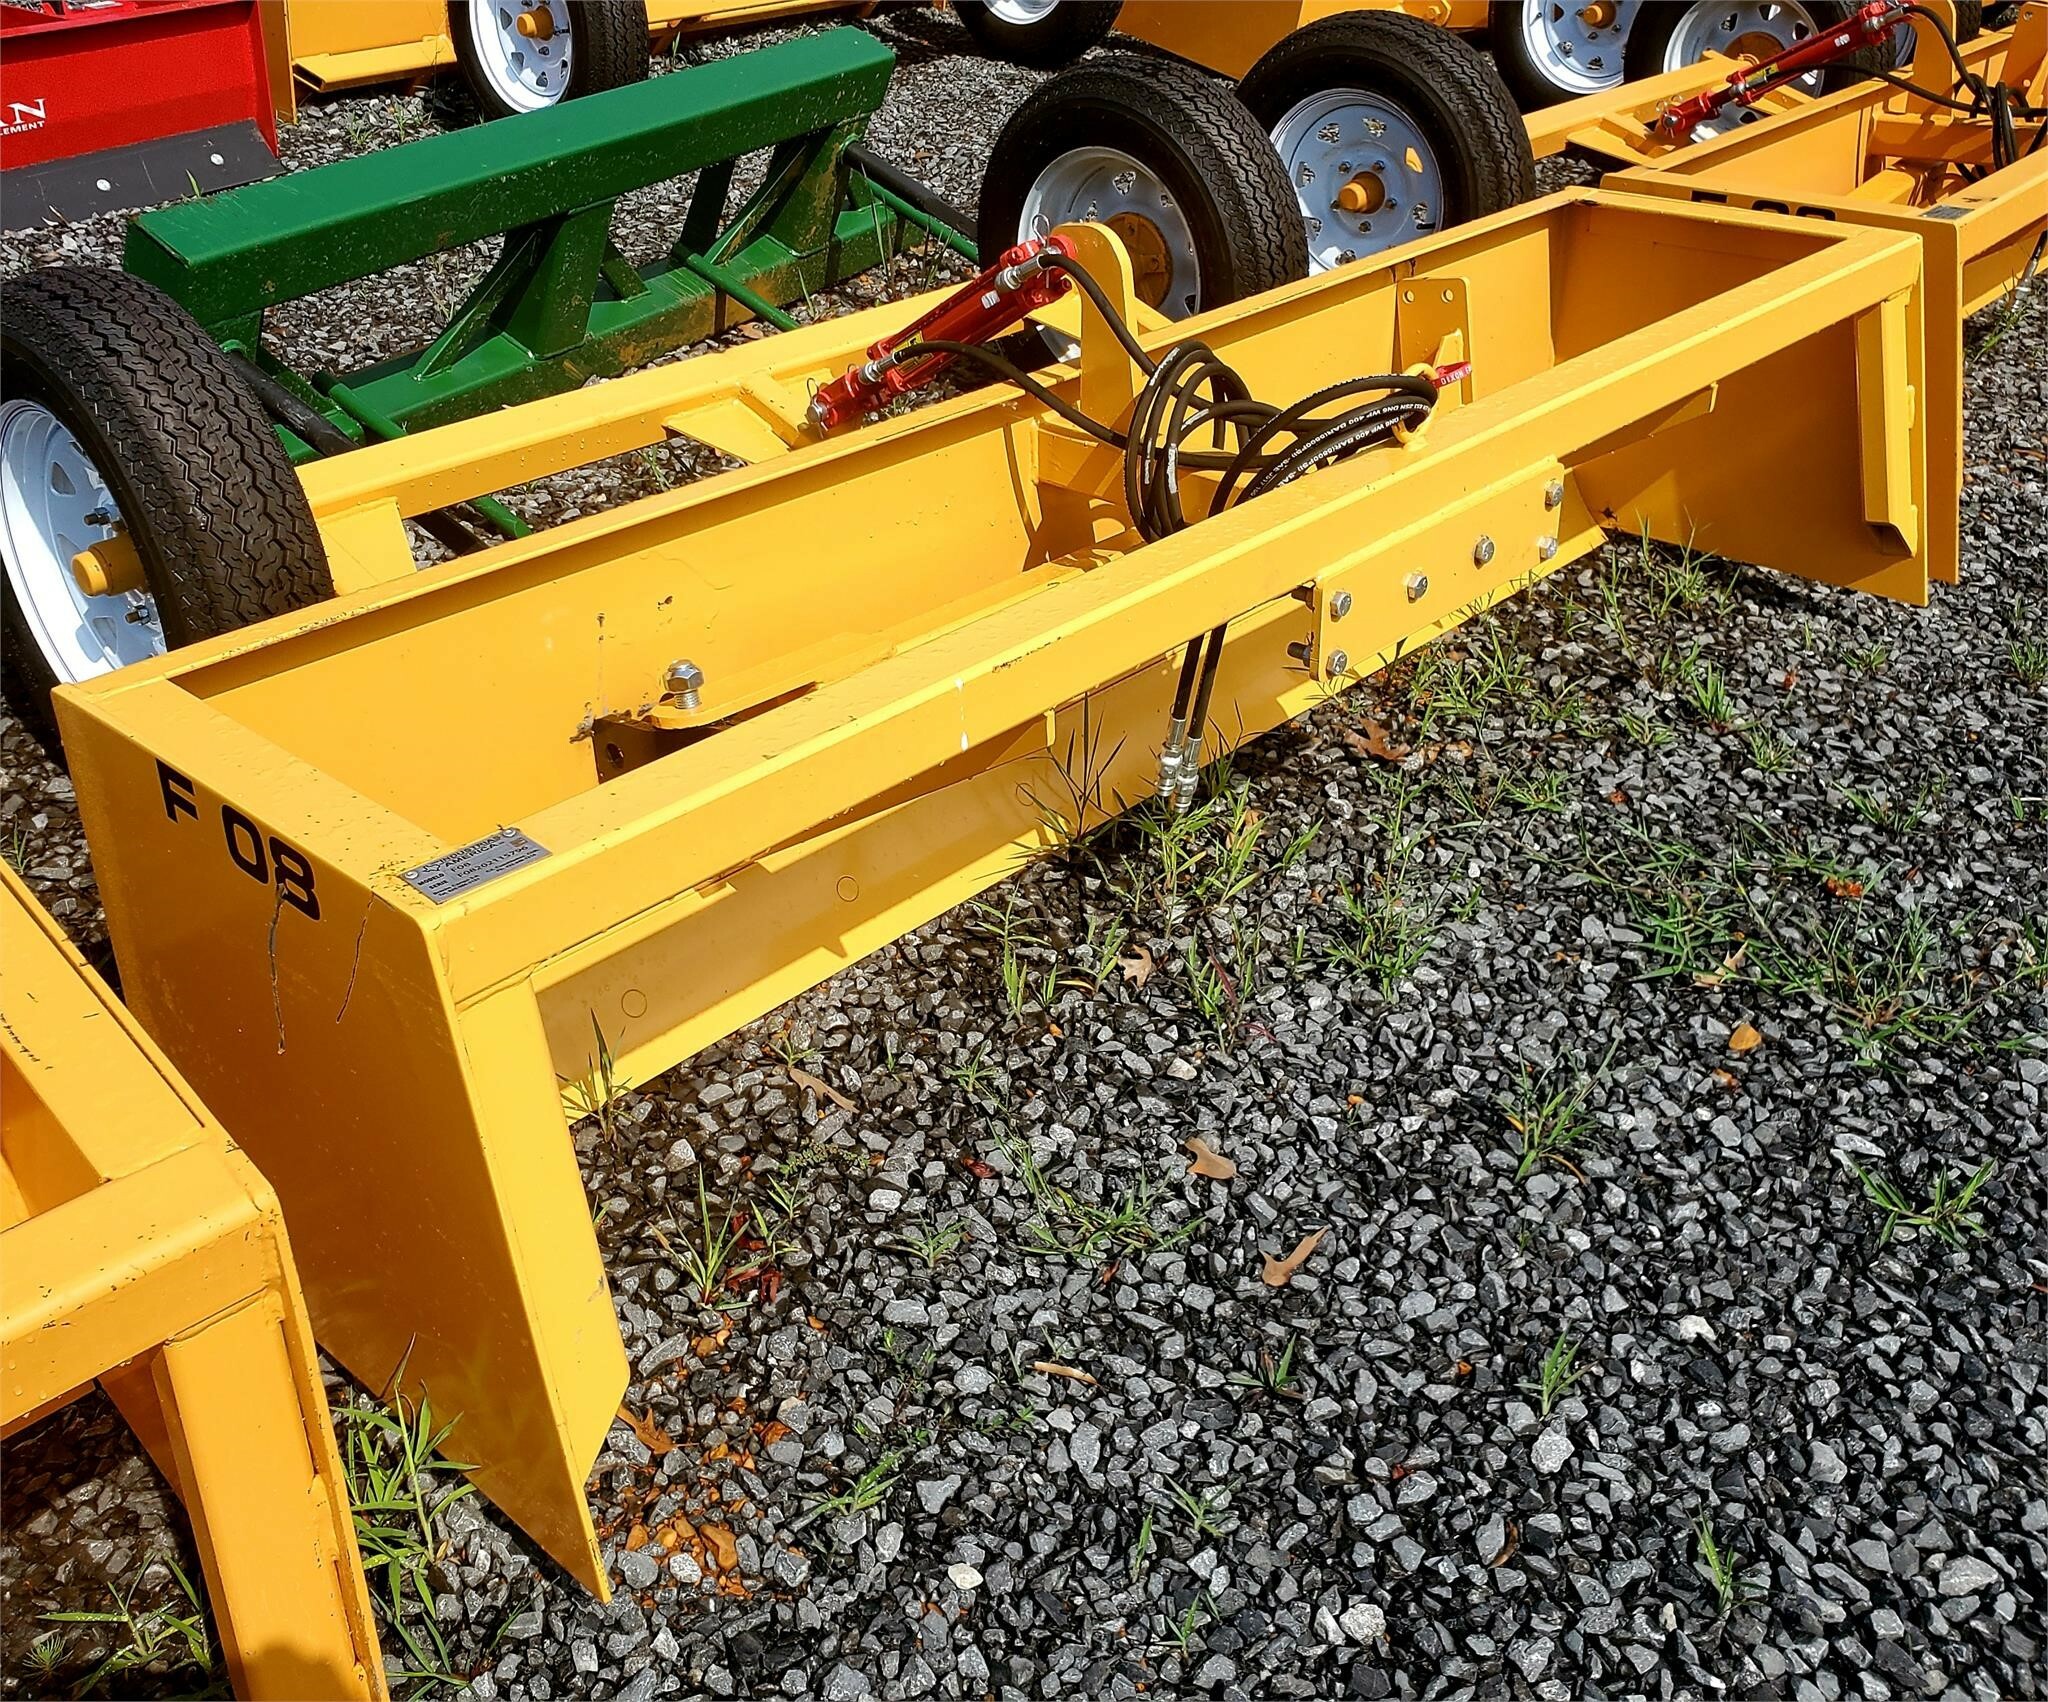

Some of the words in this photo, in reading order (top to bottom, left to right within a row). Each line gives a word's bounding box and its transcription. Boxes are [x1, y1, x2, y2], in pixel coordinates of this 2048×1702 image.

[0, 98, 47, 128] N
[1348, 415, 1366, 426] 400
[1366, 410, 1381, 419] WP
[1355, 430, 1371, 441] 400
[155, 757, 200, 824] F
[221, 803, 321, 922] 08
[444, 843, 498, 868] AMERICA
[417, 872, 445, 887] MODELO
[429, 880, 449, 890] SERIE
